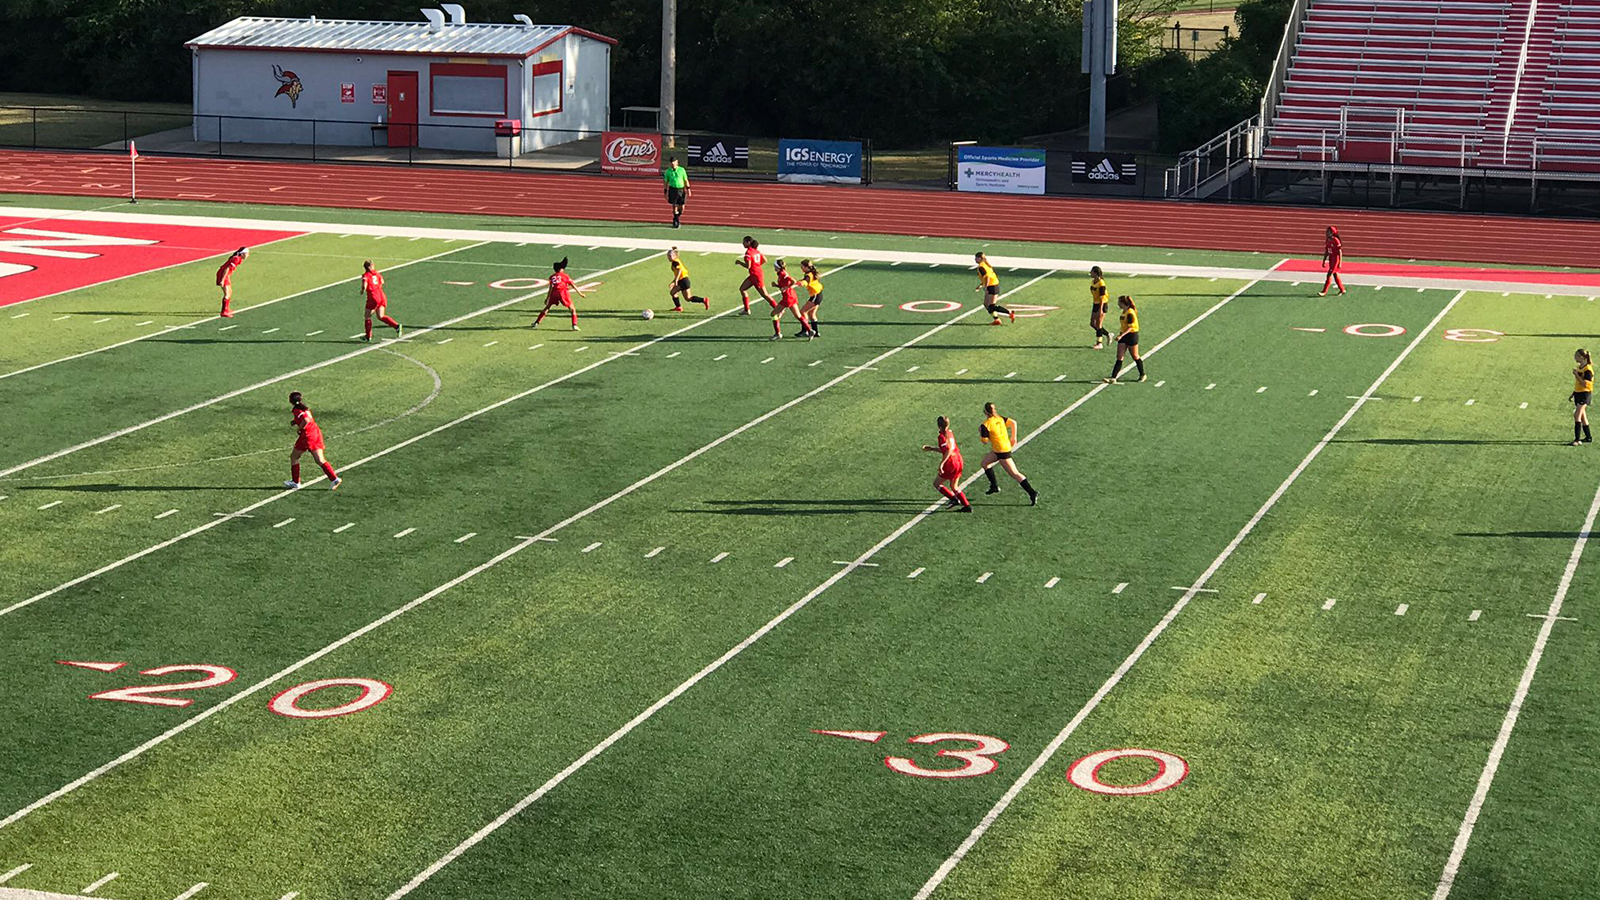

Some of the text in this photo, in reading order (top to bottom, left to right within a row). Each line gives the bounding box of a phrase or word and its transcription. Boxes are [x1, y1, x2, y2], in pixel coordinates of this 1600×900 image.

[608, 137, 656, 162] Cane's
[702, 155, 733, 164] adidas
[785, 147, 853, 163] IGS ENERGY
[1088, 171, 1119, 180] adidas
[371, 275, 378, 285] 2
[551, 275, 562, 284] 23
